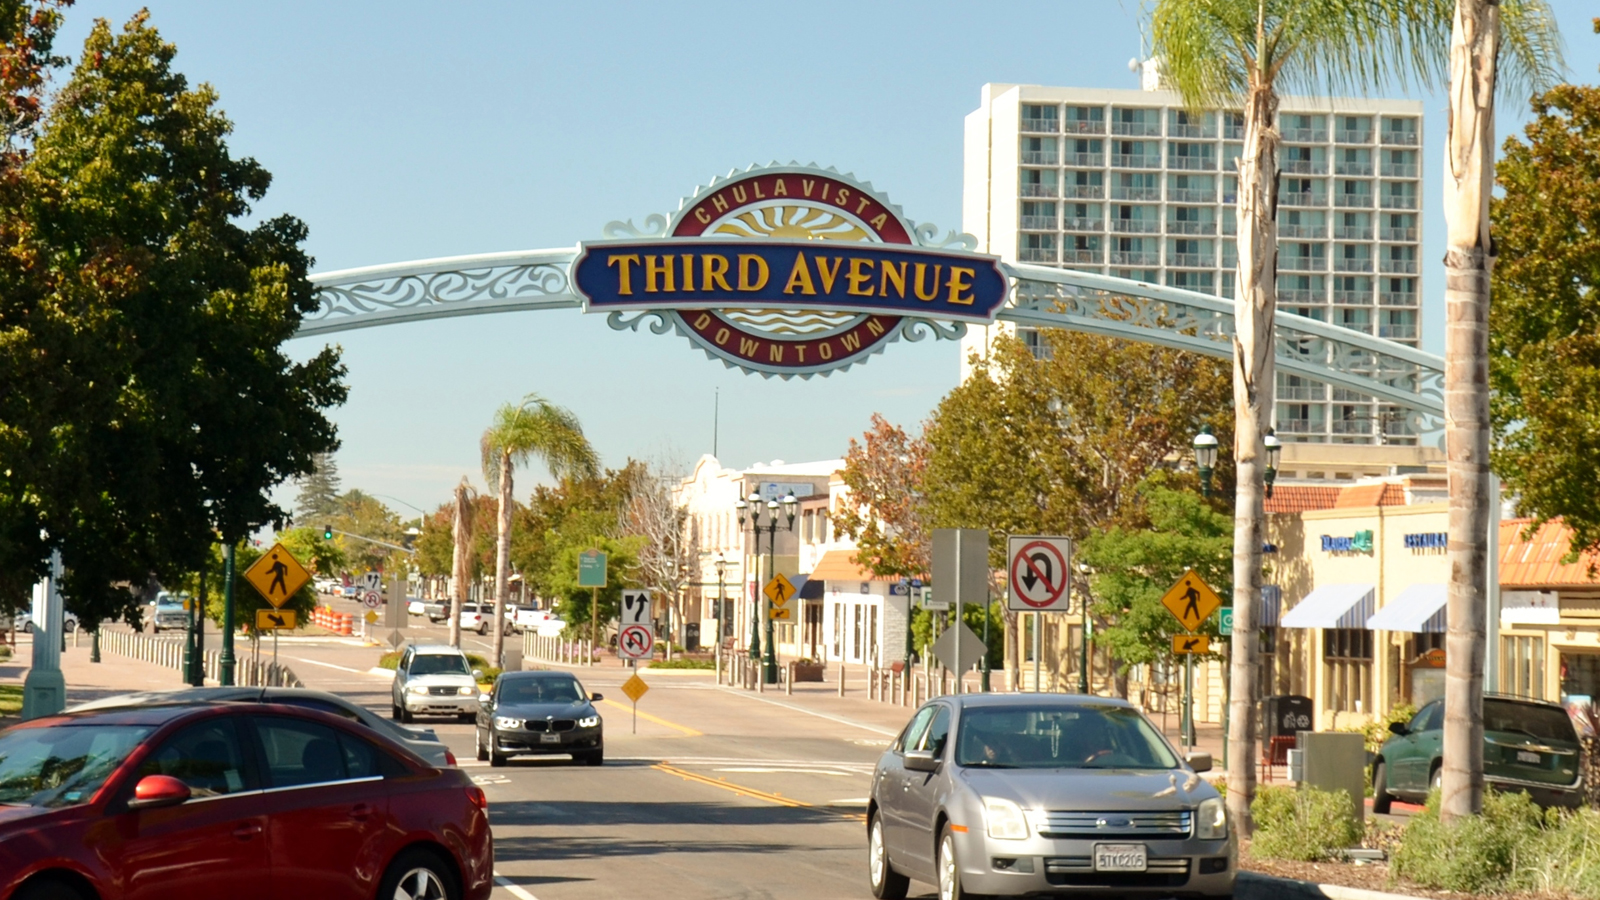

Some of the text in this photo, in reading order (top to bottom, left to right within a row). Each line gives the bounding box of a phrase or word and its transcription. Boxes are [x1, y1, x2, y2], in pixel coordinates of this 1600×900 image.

[694, 178, 888, 231] CHULA VISTA
[608, 251, 976, 306] THIRD AVENUE
[693, 313, 885, 363] DOWNTOWN
